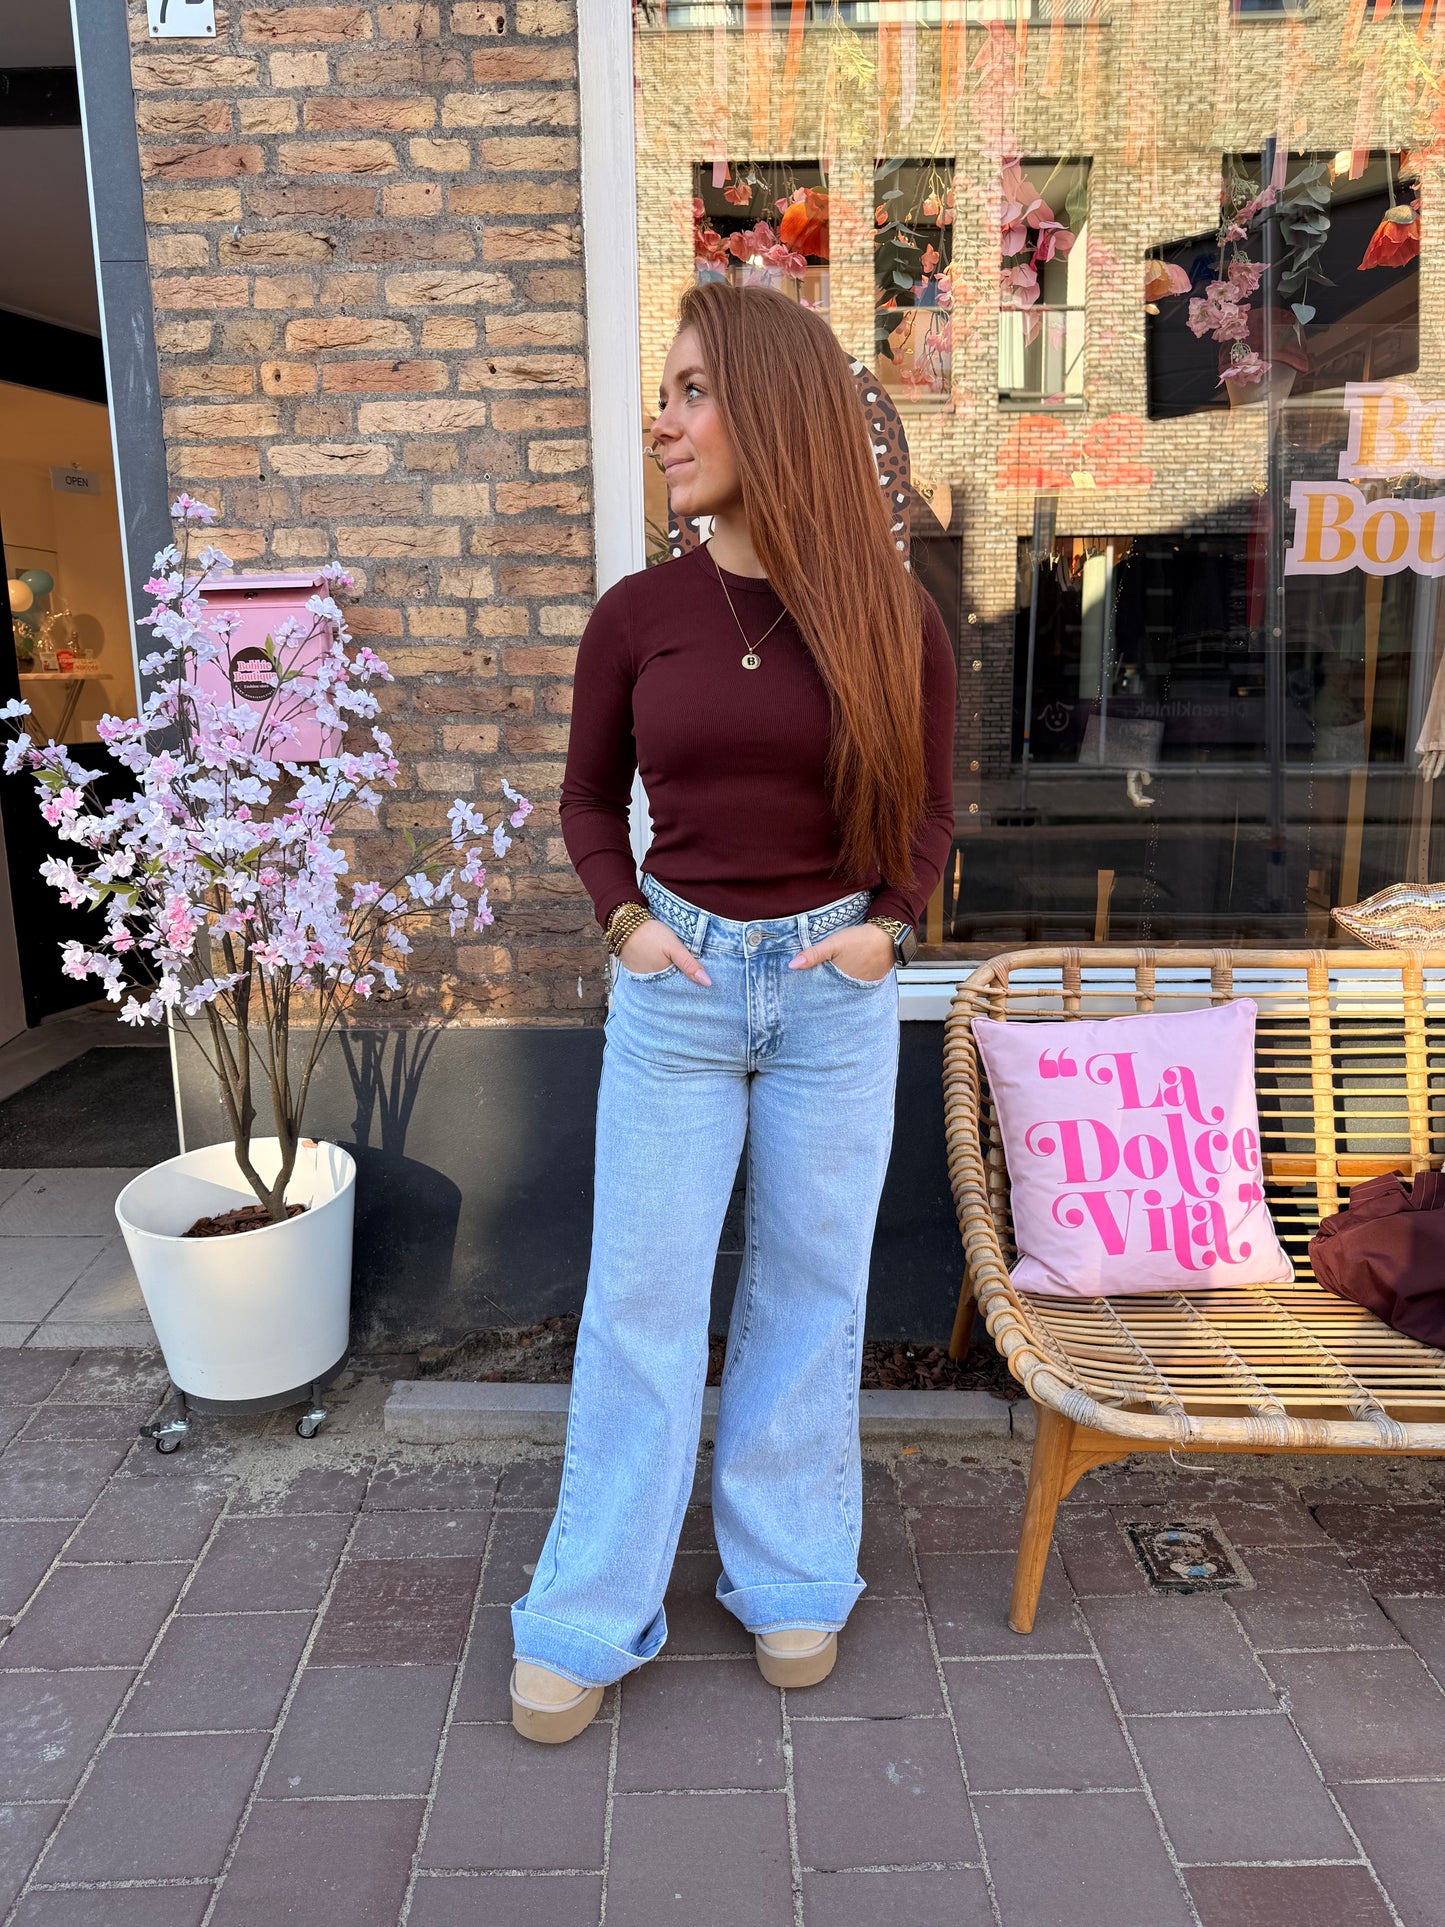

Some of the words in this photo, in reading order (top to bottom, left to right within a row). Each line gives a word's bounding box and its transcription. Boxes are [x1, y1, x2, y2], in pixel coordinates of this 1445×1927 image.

[65, 475, 89, 487] OPEN
[238, 660, 271, 671] Bobbie
[747, 656, 756, 666] B
[1025, 1113, 1258, 1199] Dolce
